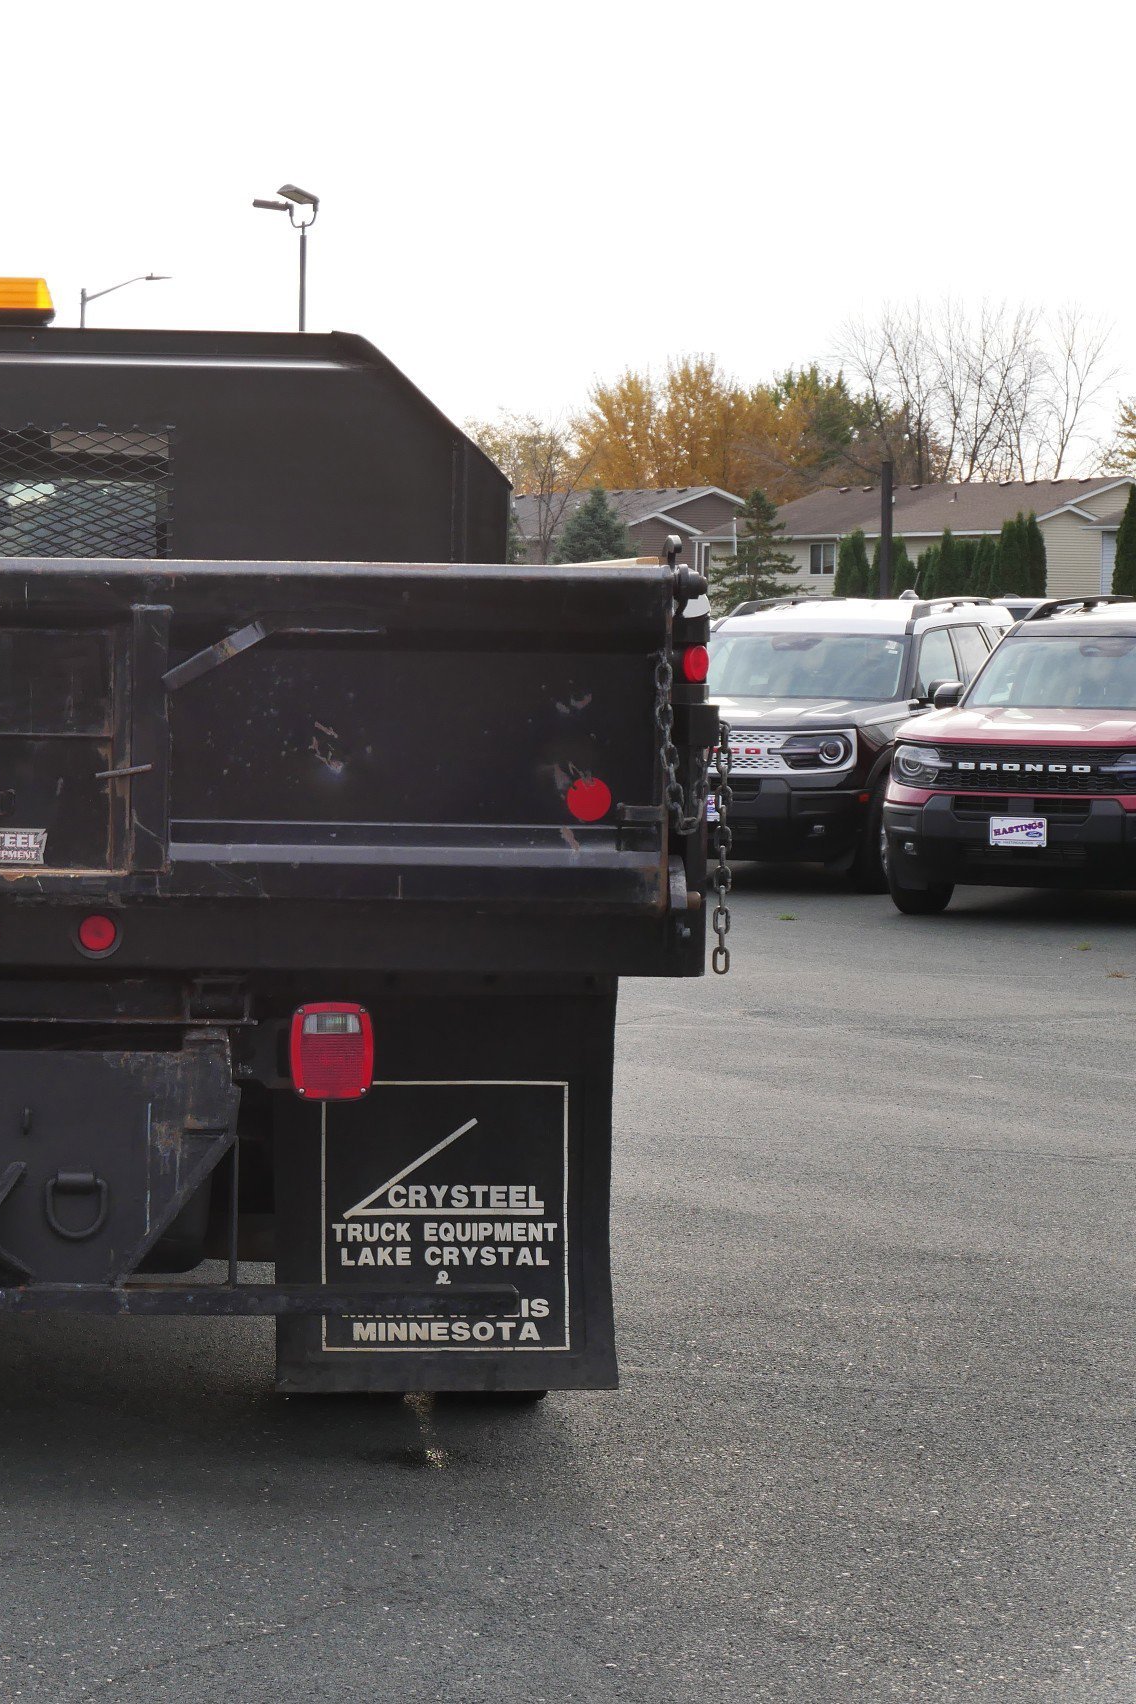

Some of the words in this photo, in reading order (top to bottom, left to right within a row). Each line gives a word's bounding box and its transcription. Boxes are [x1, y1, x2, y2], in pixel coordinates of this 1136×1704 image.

[958, 762, 1091, 772] BRONCO
[993, 821, 1044, 836] HASTINGS
[388, 1185, 545, 1208] CRYSTEEL
[332, 1222, 412, 1242] TRUCK
[423, 1222, 558, 1242] EQUIPMENT
[341, 1247, 412, 1266] LAKE
[424, 1246, 550, 1266] CRYSTAL
[435, 1270, 452, 1285] &
[353, 1322, 541, 1342] MINNESOTA
